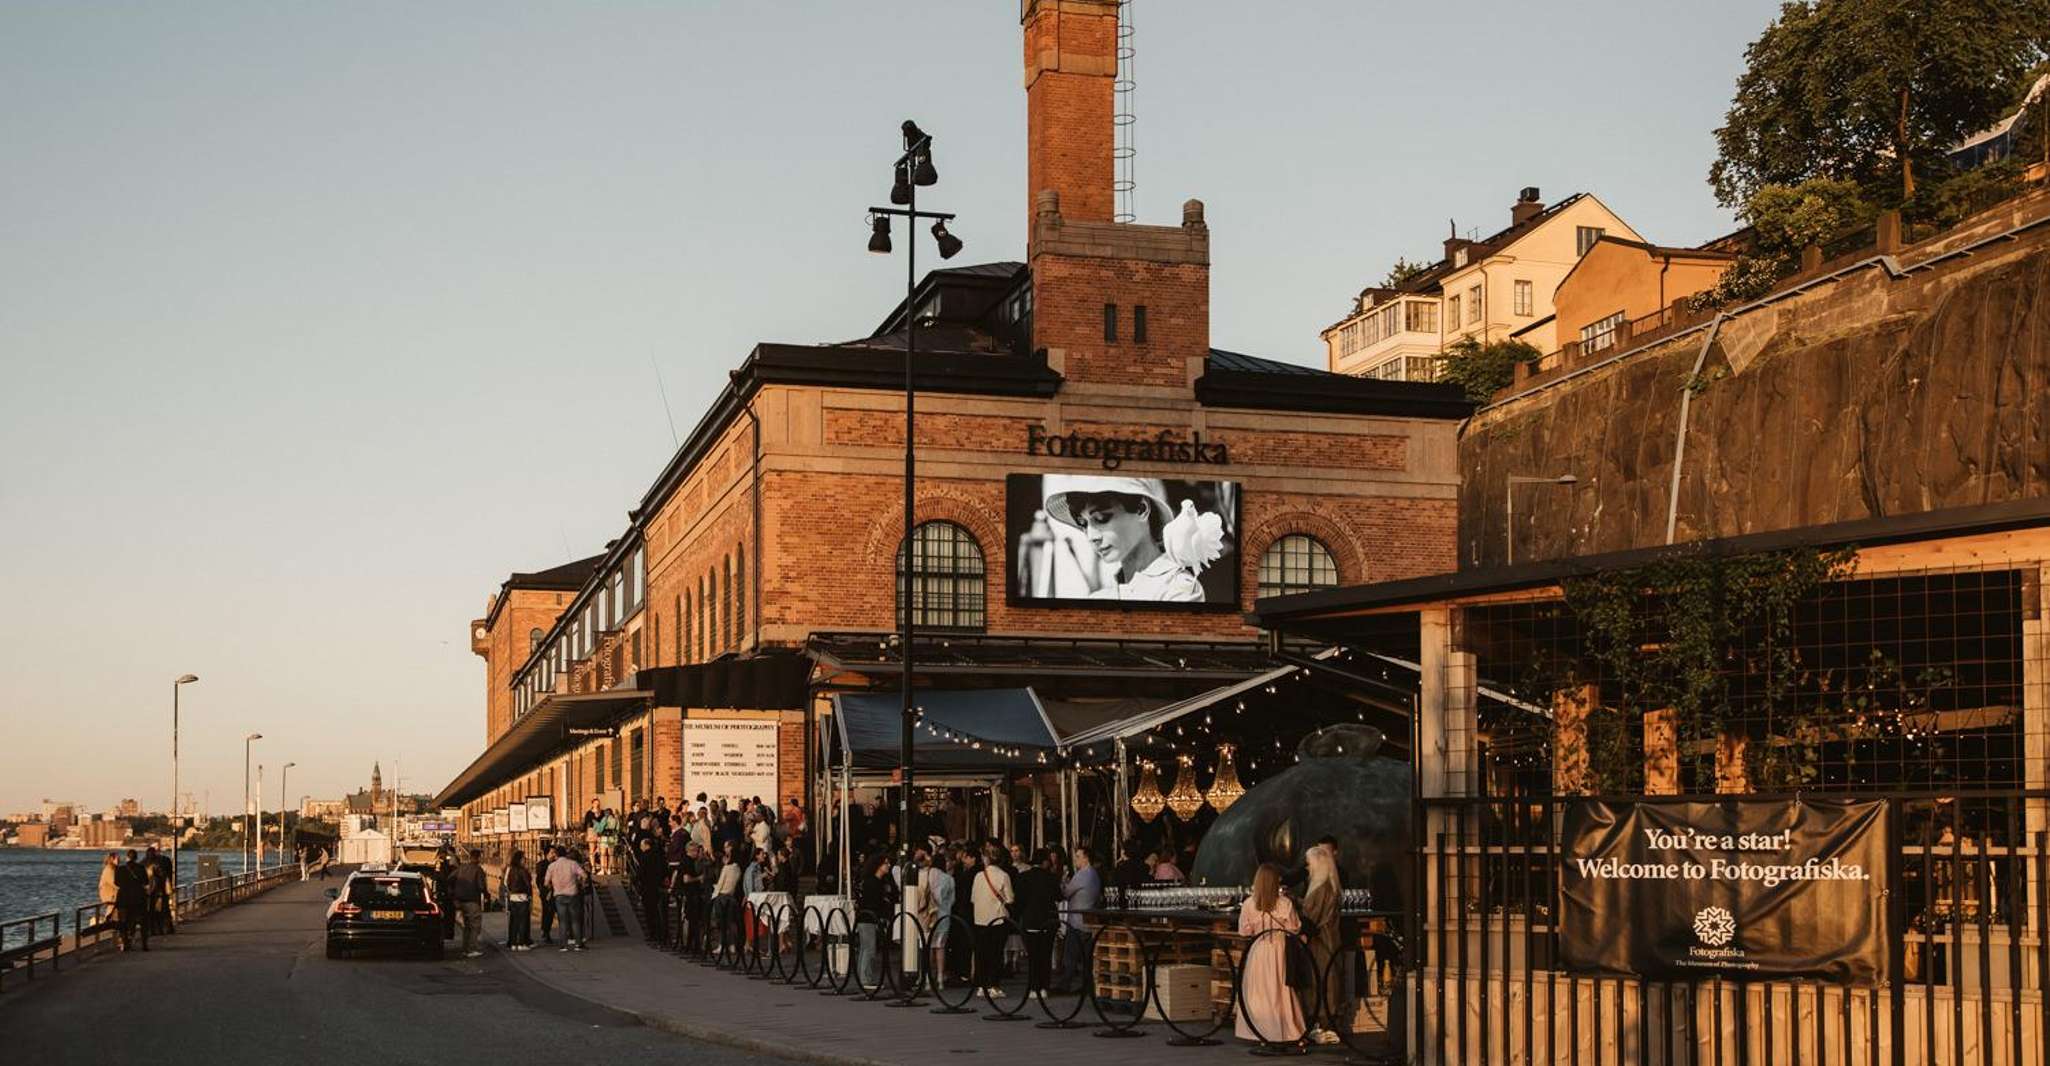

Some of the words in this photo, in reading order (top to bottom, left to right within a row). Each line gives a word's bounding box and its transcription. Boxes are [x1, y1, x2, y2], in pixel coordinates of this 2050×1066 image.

[1027, 425, 1229, 470] Fotografiska
[1645, 828, 1718, 850] You’re
[1721, 834, 1735, 850] a
[1738, 828, 1790, 850] star!
[1577, 858, 1677, 880] Welcome
[1683, 861, 1706, 880] to
[1710, 858, 1870, 887] Fotografiska.
[1689, 946, 1745, 959] Fotografiska
